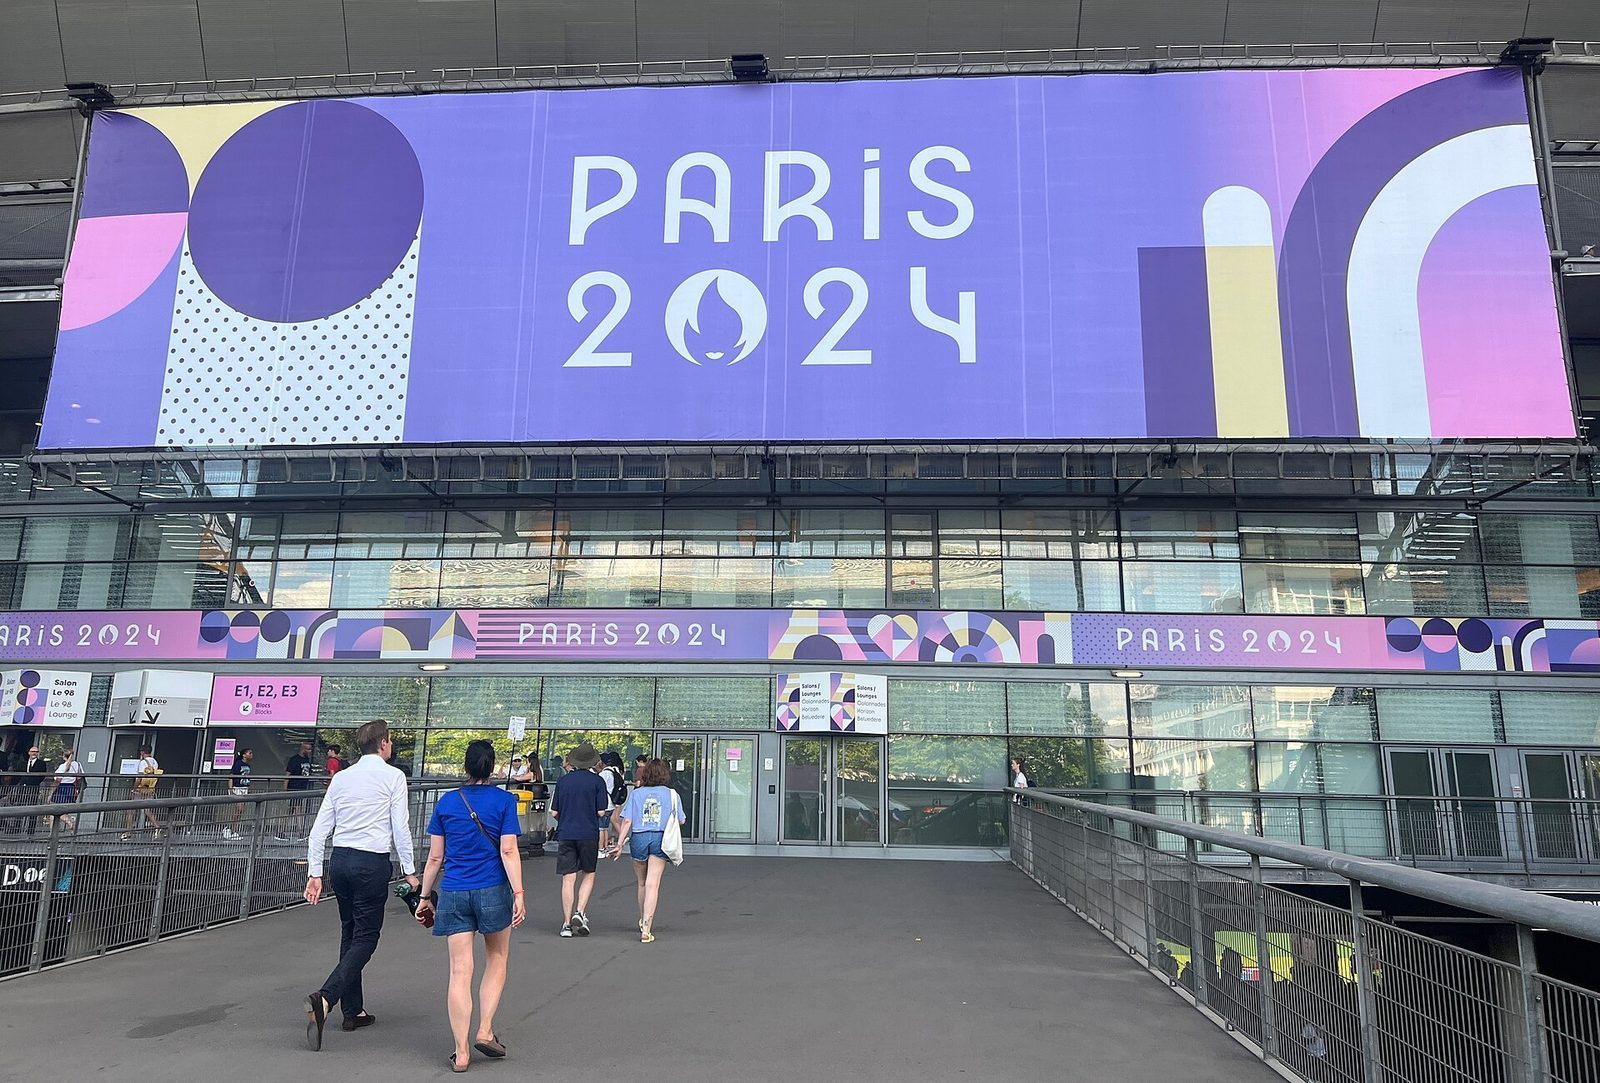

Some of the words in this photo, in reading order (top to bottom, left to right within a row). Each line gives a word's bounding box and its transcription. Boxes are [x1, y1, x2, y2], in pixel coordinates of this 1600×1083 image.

[562, 266, 977, 367] 2024
[77, 624, 161, 646] 2024
[634, 622, 726, 646] 2024
[1241, 629, 1342, 654] 2024
[54, 679, 77, 687] Salon
[234, 685, 254, 699] E1,
[257, 685, 278, 699] E2,
[281, 685, 298, 697] E3
[64, 689, 75, 697] 98
[48, 711, 78, 720] Lounge
